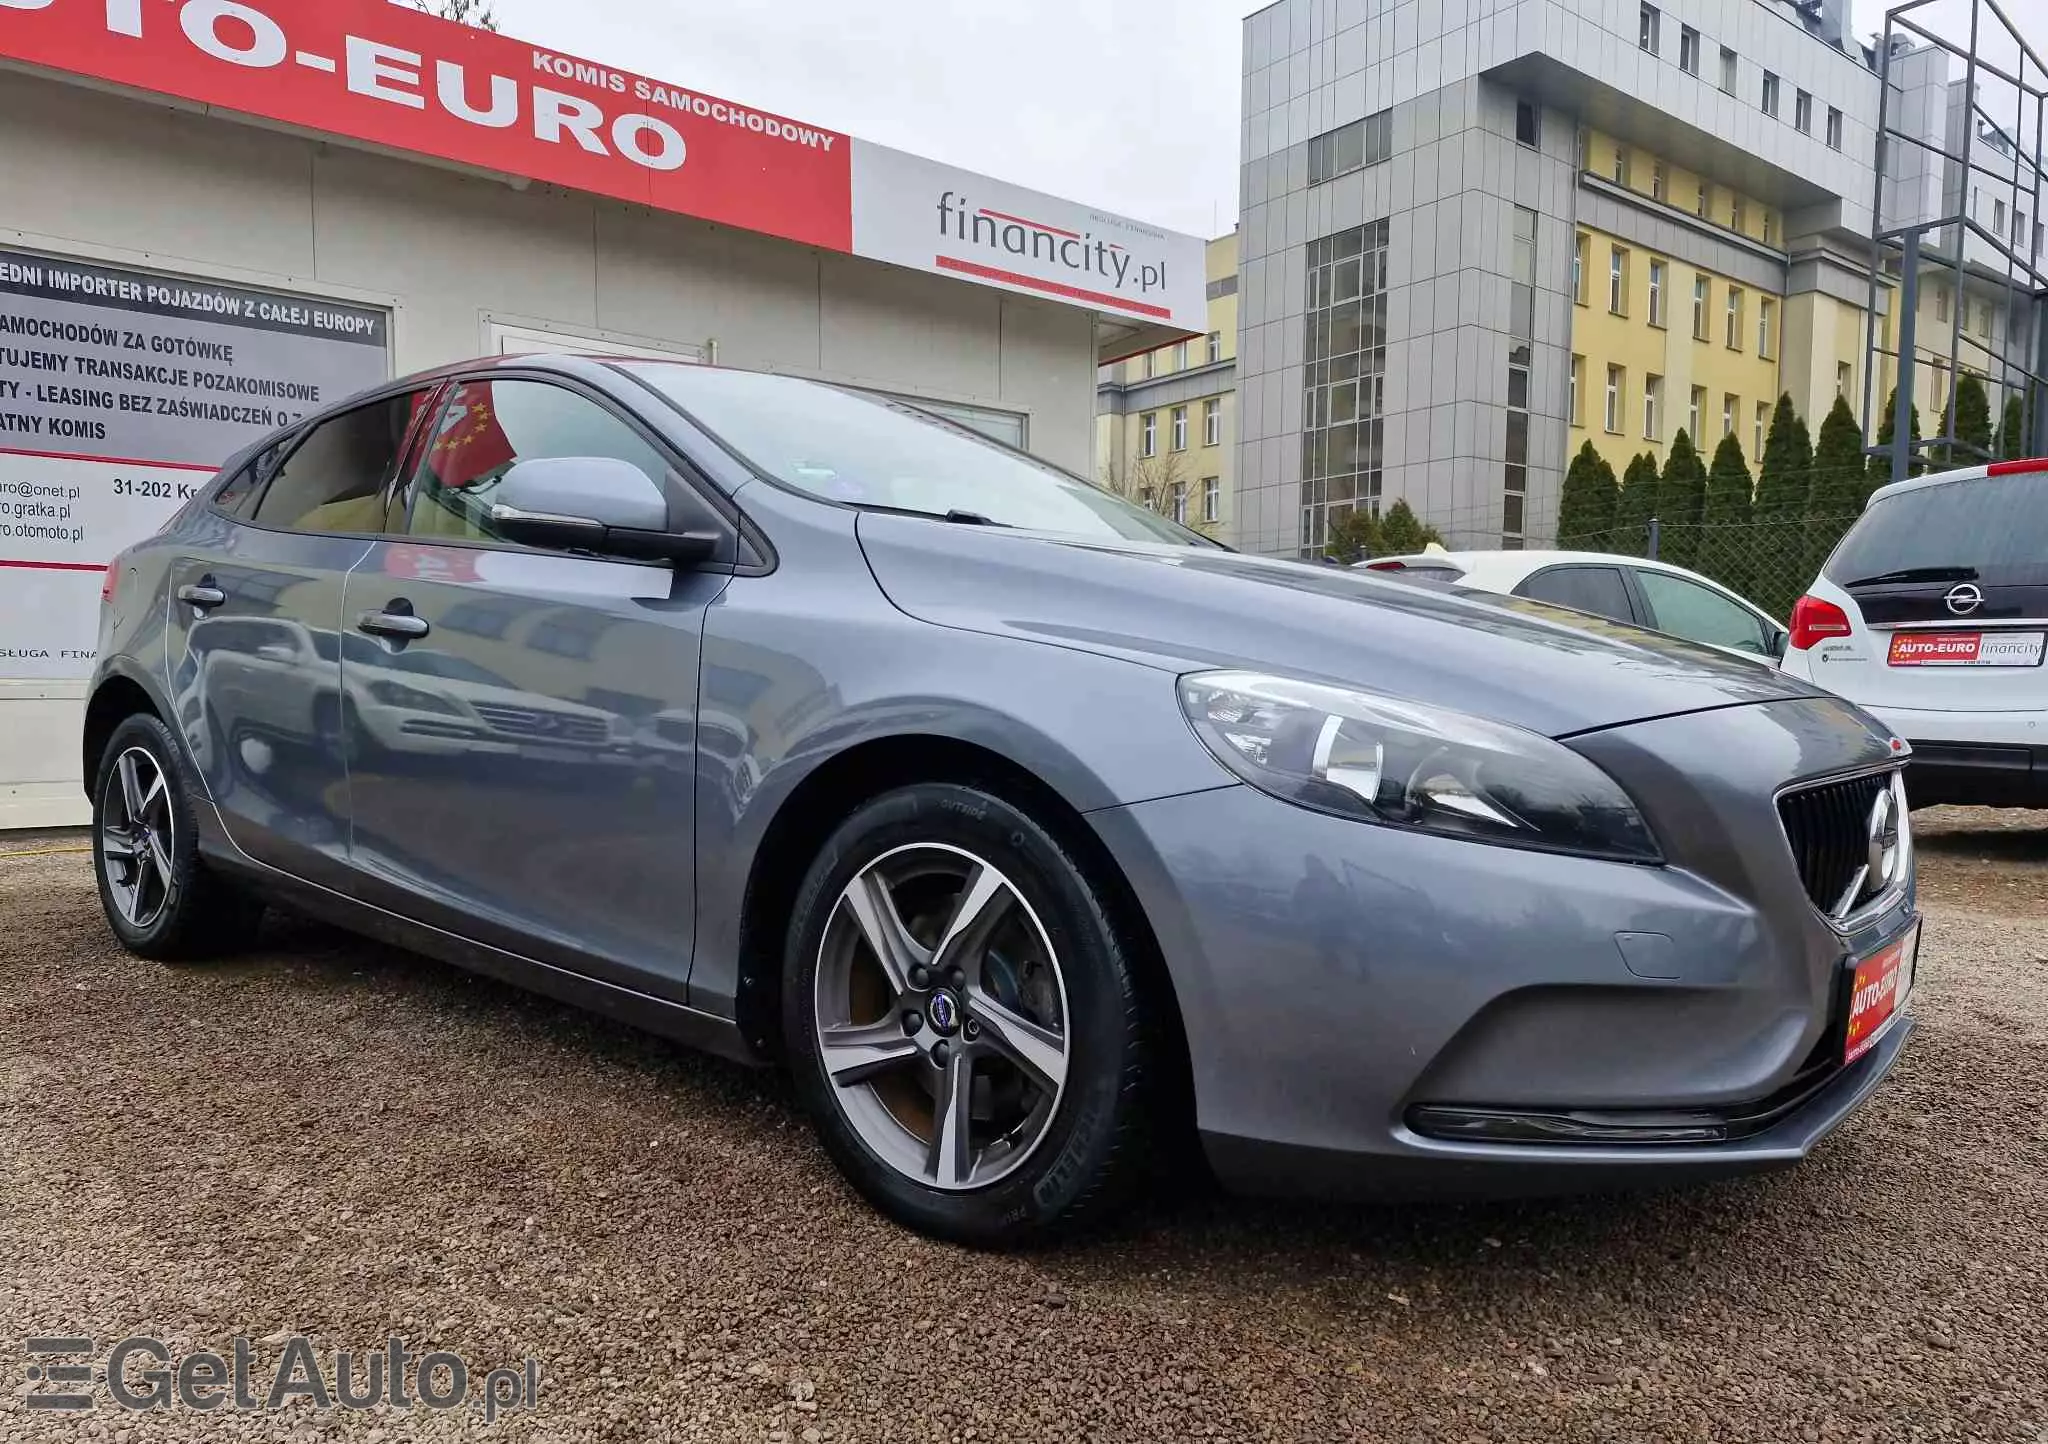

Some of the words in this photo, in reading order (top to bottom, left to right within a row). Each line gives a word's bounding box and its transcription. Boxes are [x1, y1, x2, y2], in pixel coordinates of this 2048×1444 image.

[0, 0, 687, 170] TO-EURO
[532, 51, 626, 92] KOMIS
[634, 80, 833, 151] SAMOCHODOWY
[936, 191, 1167, 293] financity.pl
[0, 263, 42, 286] EDNI
[48, 270, 142, 301] IMPORTER
[147, 285, 240, 316] POJAZDÓW
[244, 301, 256, 318] Z
[259, 303, 309, 325] CAŁEJ
[313, 311, 375, 336] EUROPY
[0, 314, 118, 347] AMOCHODÓW
[122, 332, 146, 350] ZA
[151, 335, 233, 366] GOTÓWKĘ
[75, 357, 188, 387] TRANSAKCJE
[193, 372, 319, 402] POZAKOMISOWE
[0, 380, 20, 399] TY
[37, 384, 114, 409] LEASING
[119, 394, 153, 414] BEZ
[157, 396, 272, 426] ZAŚWIADCZEŃ
[277, 411, 288, 427] O
[49, 417, 106, 439] KOMIS
[0, 501, 71, 521] o.gratka.pl
[113, 479, 172, 498] 31-202
[1900, 643, 1976, 654] AUTO-EURO
